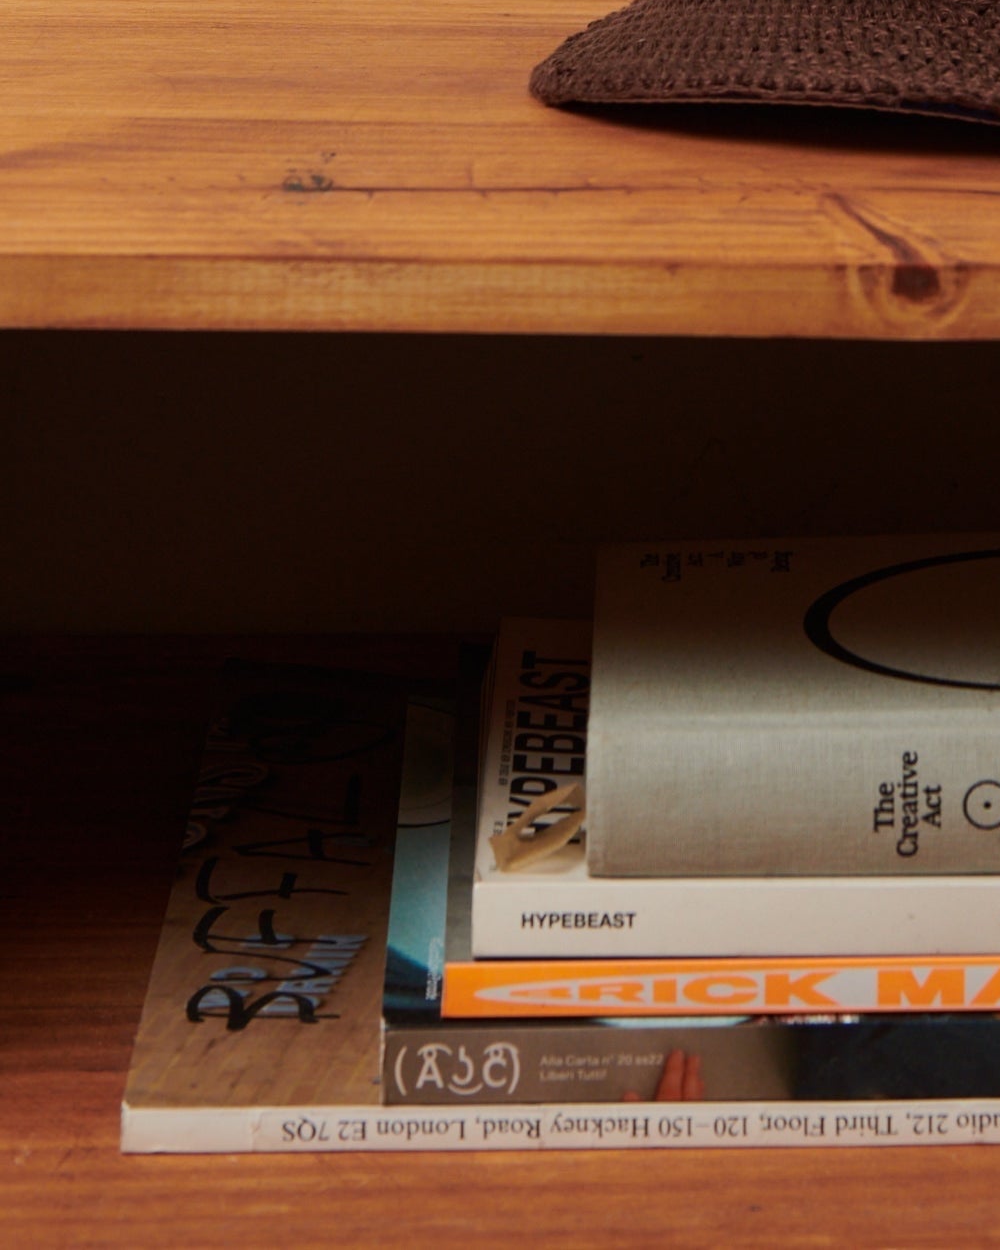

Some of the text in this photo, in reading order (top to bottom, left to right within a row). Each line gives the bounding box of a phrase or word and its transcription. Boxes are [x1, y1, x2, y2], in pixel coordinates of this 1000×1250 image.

[873, 781, 895, 833] The
[896, 750, 918, 859] Creative
[922, 784, 942, 828] Act
[521, 912, 637, 929] HYPEBEAST
[282, 1118, 330, 1143] 7QS
[338, 1119, 367, 1141] E2
[376, 1118, 466, 1141] London
[475, 1116, 541, 1140] Road,
[550, 1112, 650, 1139] Hackney
[760, 1113, 825, 1137] Floor,
[835, 1114, 898, 1137] Third
[905, 1112, 948, 1134] 212,
